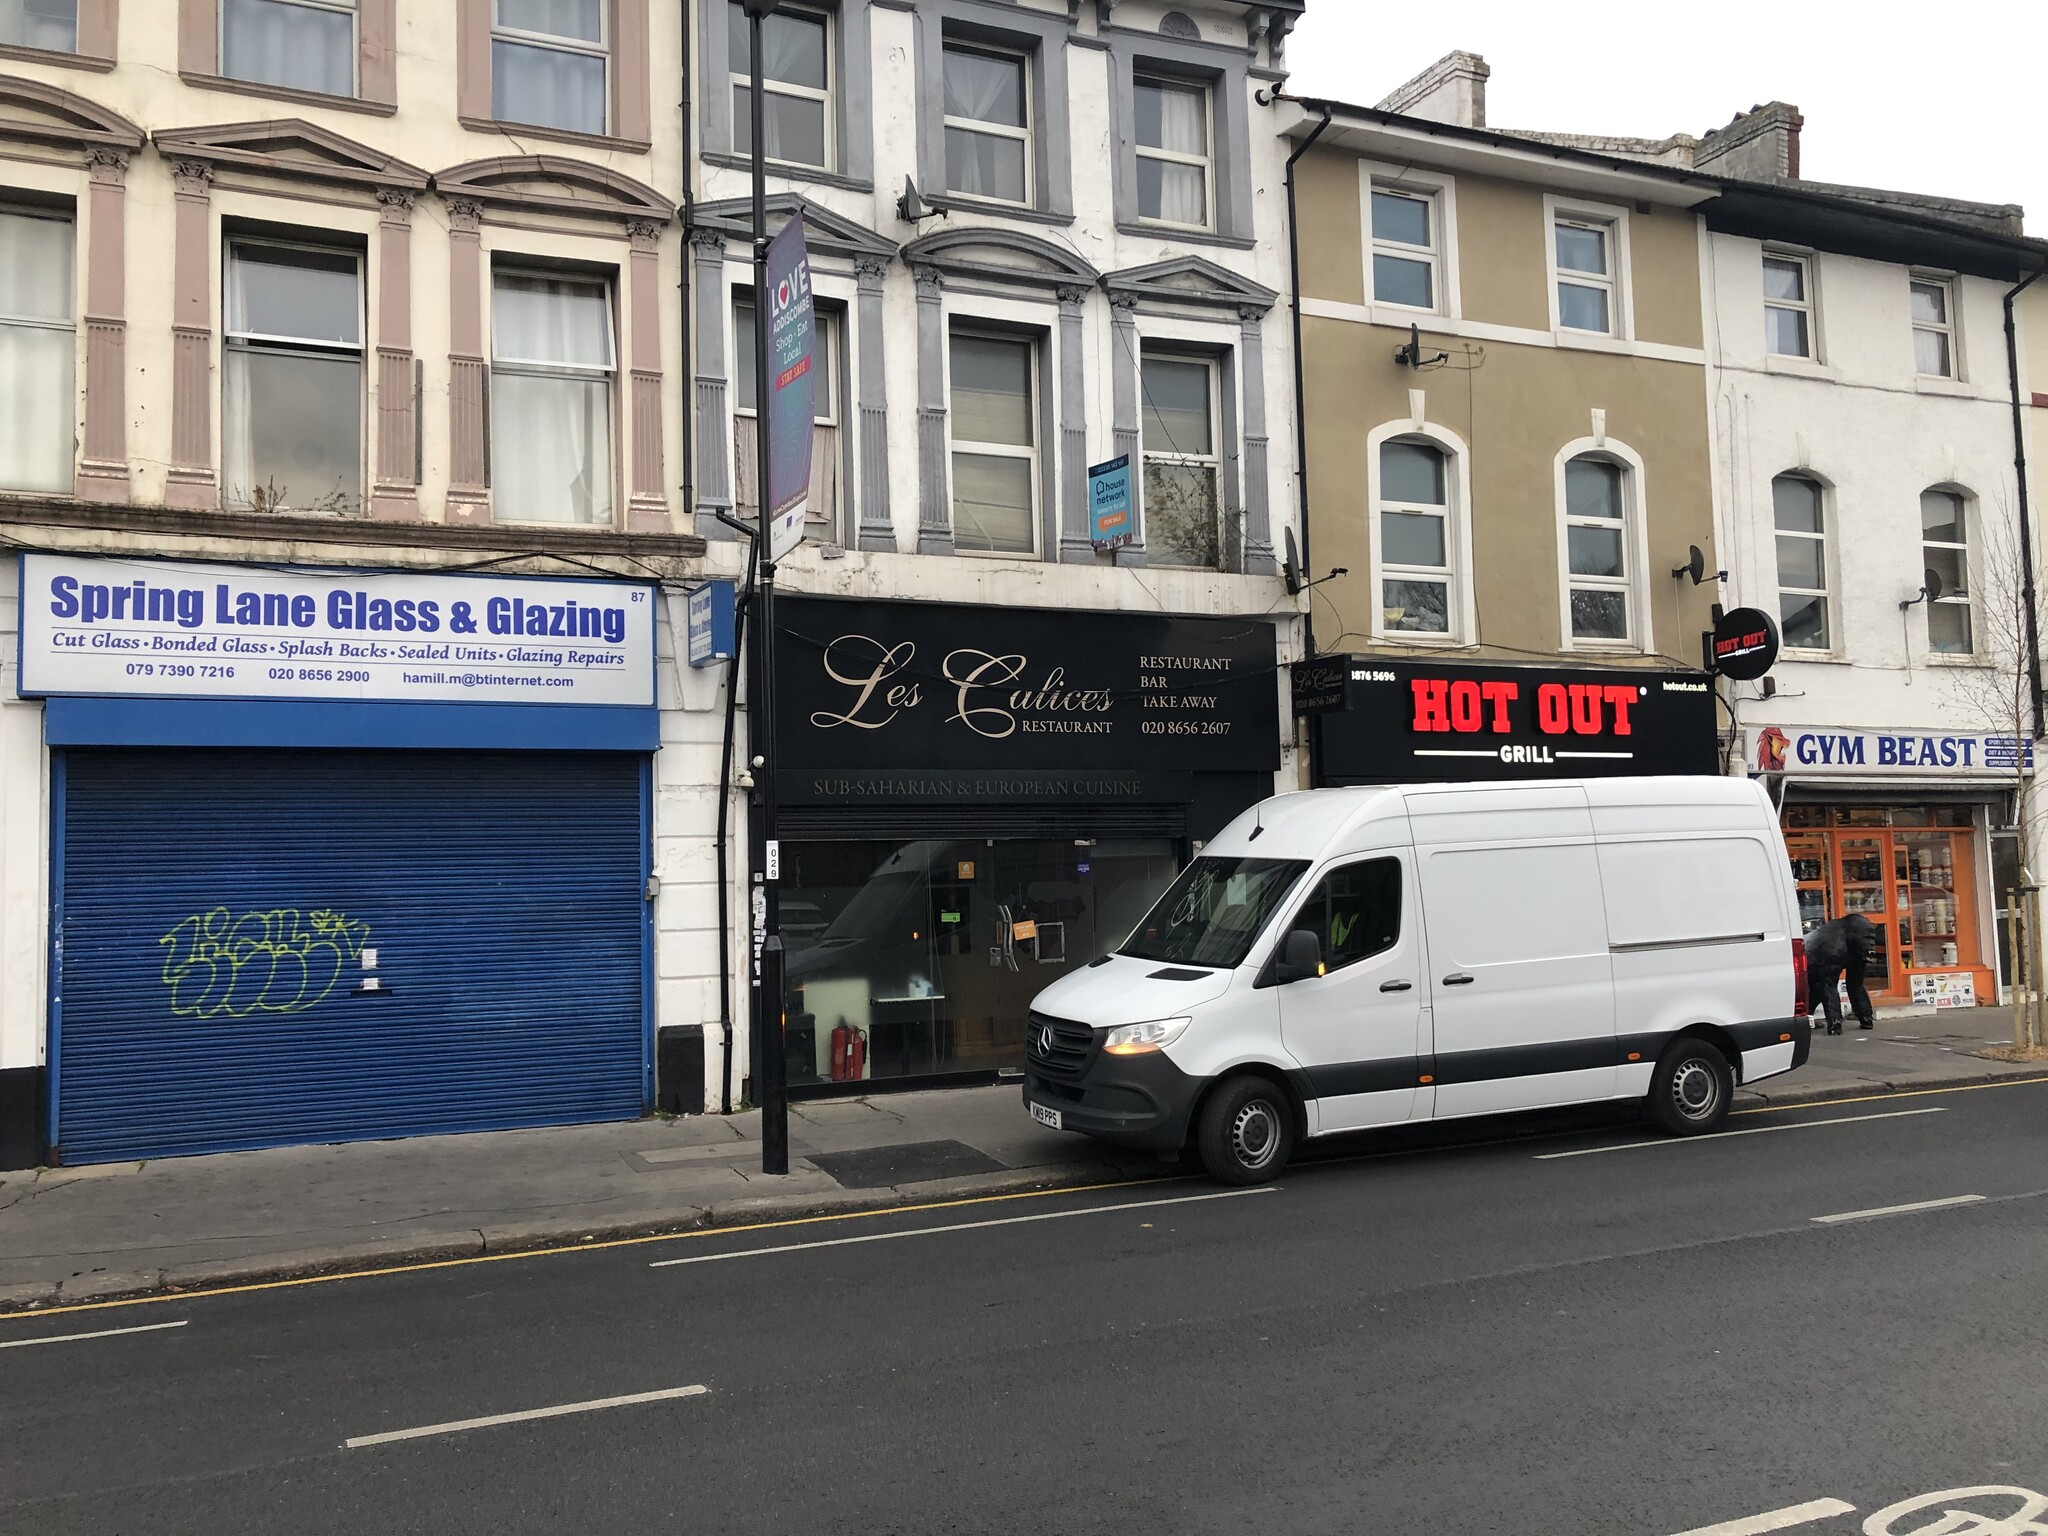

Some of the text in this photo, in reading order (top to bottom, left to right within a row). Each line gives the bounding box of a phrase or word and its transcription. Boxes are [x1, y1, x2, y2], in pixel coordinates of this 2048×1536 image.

[771, 259, 809, 319] LOVE
[773, 294, 810, 336] ADDISCOMBE
[775, 319, 809, 353] Shop Eat
[783, 341, 802, 365] Local
[781, 360, 806, 387] STAY SAFE
[1105, 478, 1125, 492] house
[1096, 490, 1126, 505] network
[631, 591, 646, 603] 87
[50, 575, 626, 644] Spring Lane Glass & Glazing
[52, 631, 626, 668] Cut Glass Bonded Glass Splash Backs Sealed Units Glazing Repairs
[1716, 631, 1766, 653] HOT OUT
[1735, 648, 1750, 656] GRILL
[1140, 656, 1232, 670] RESTAURANT
[126, 663, 574, 688] 079 7390 7216 020 8656 2900 hamill.m@btinternet.com
[1141, 676, 1168, 688] BAR
[1372, 671, 1396, 682] 5696
[810, 634, 1114, 739] Les Calices
[1662, 681, 1708, 692] hotout.co.uk
[1141, 696, 1217, 708] TAKE AWAY
[1411, 679, 1638, 735] HOT OUT
[1022, 720, 1113, 734] RESTAURANT
[1141, 721, 1231, 735] 020 8656 2607
[1500, 744, 1554, 763] GRILL
[1796, 733, 1977, 767] GYM BEAST
[813, 779, 1142, 795] SUB-SAHARIAN & EUROPEAN CUISINE
[769, 848, 777, 878] 029
[1045, 1109, 1057, 1125] PPS
